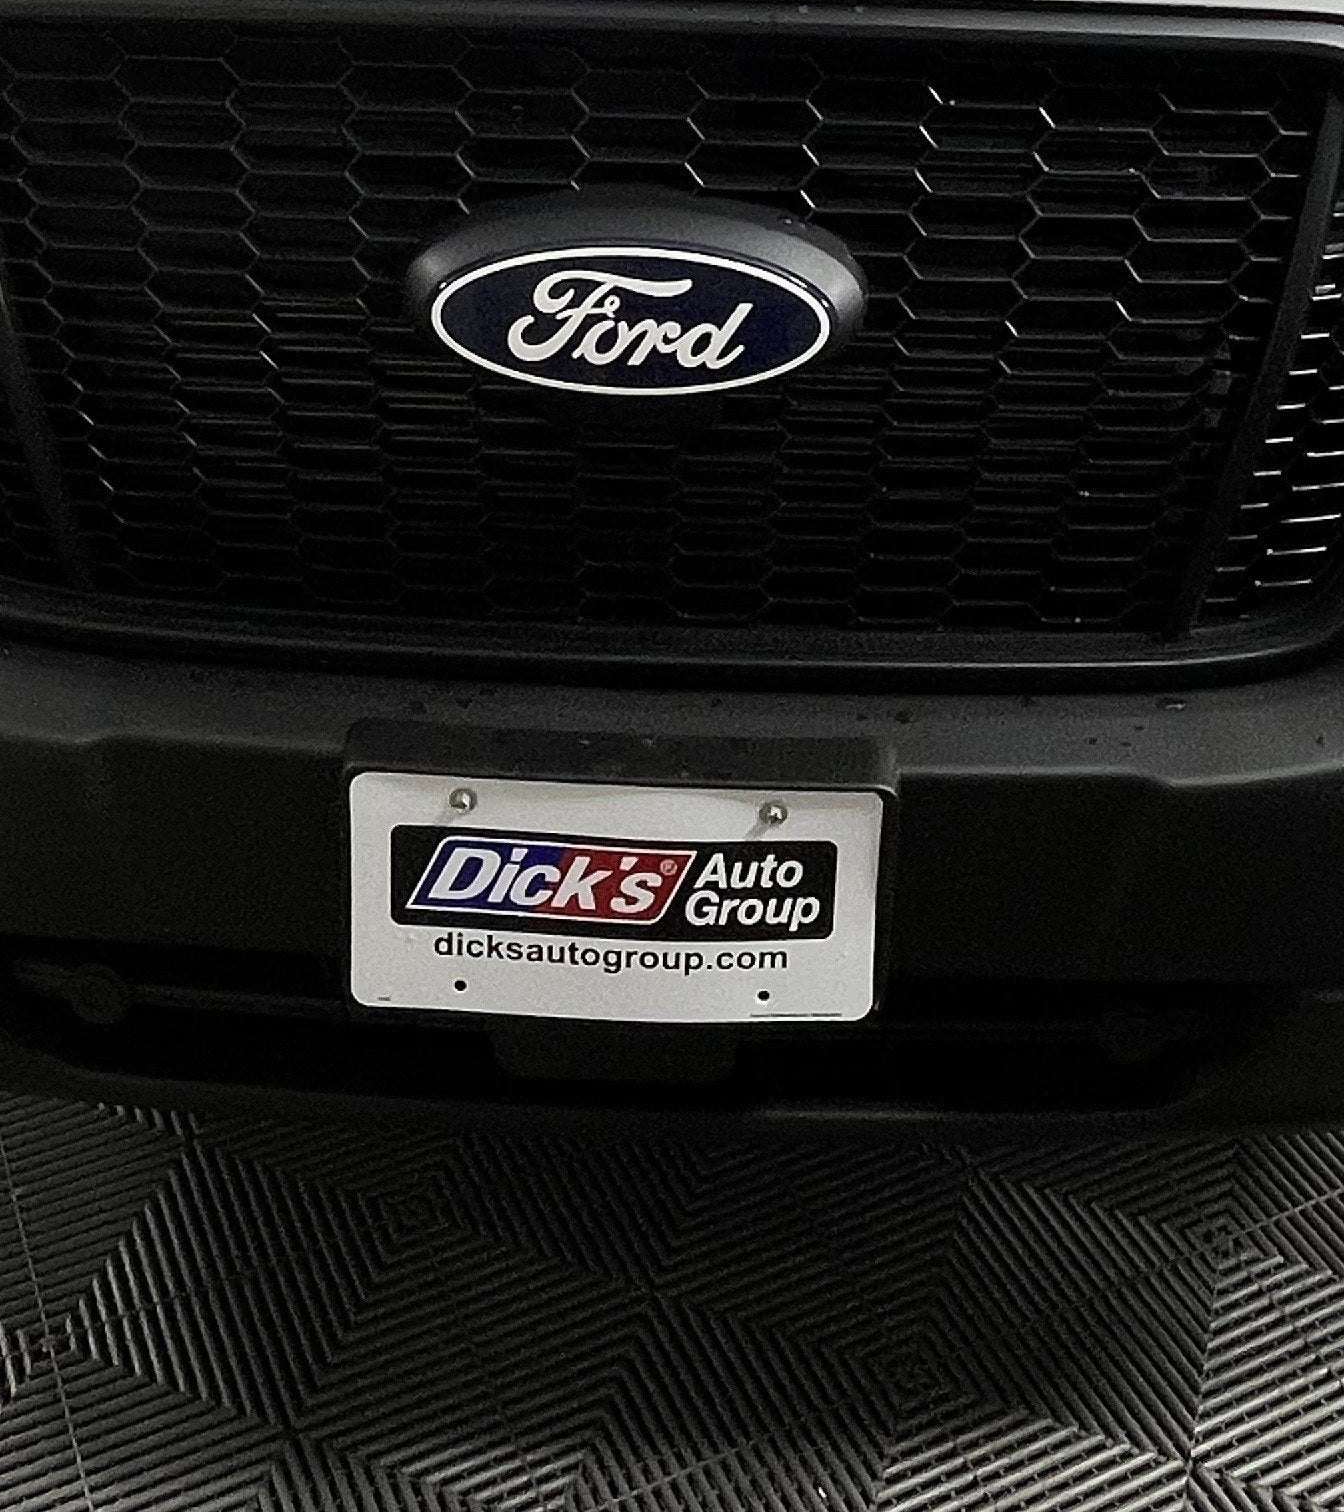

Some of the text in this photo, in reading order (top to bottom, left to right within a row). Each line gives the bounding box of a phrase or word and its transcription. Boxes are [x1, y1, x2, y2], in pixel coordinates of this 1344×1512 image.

[508, 269, 753, 370] Ford
[427, 847, 664, 914] Dick's
[695, 852, 804, 890] Auto
[685, 890, 821, 932] Group
[434, 932, 788, 975] dicksautogroup.com
